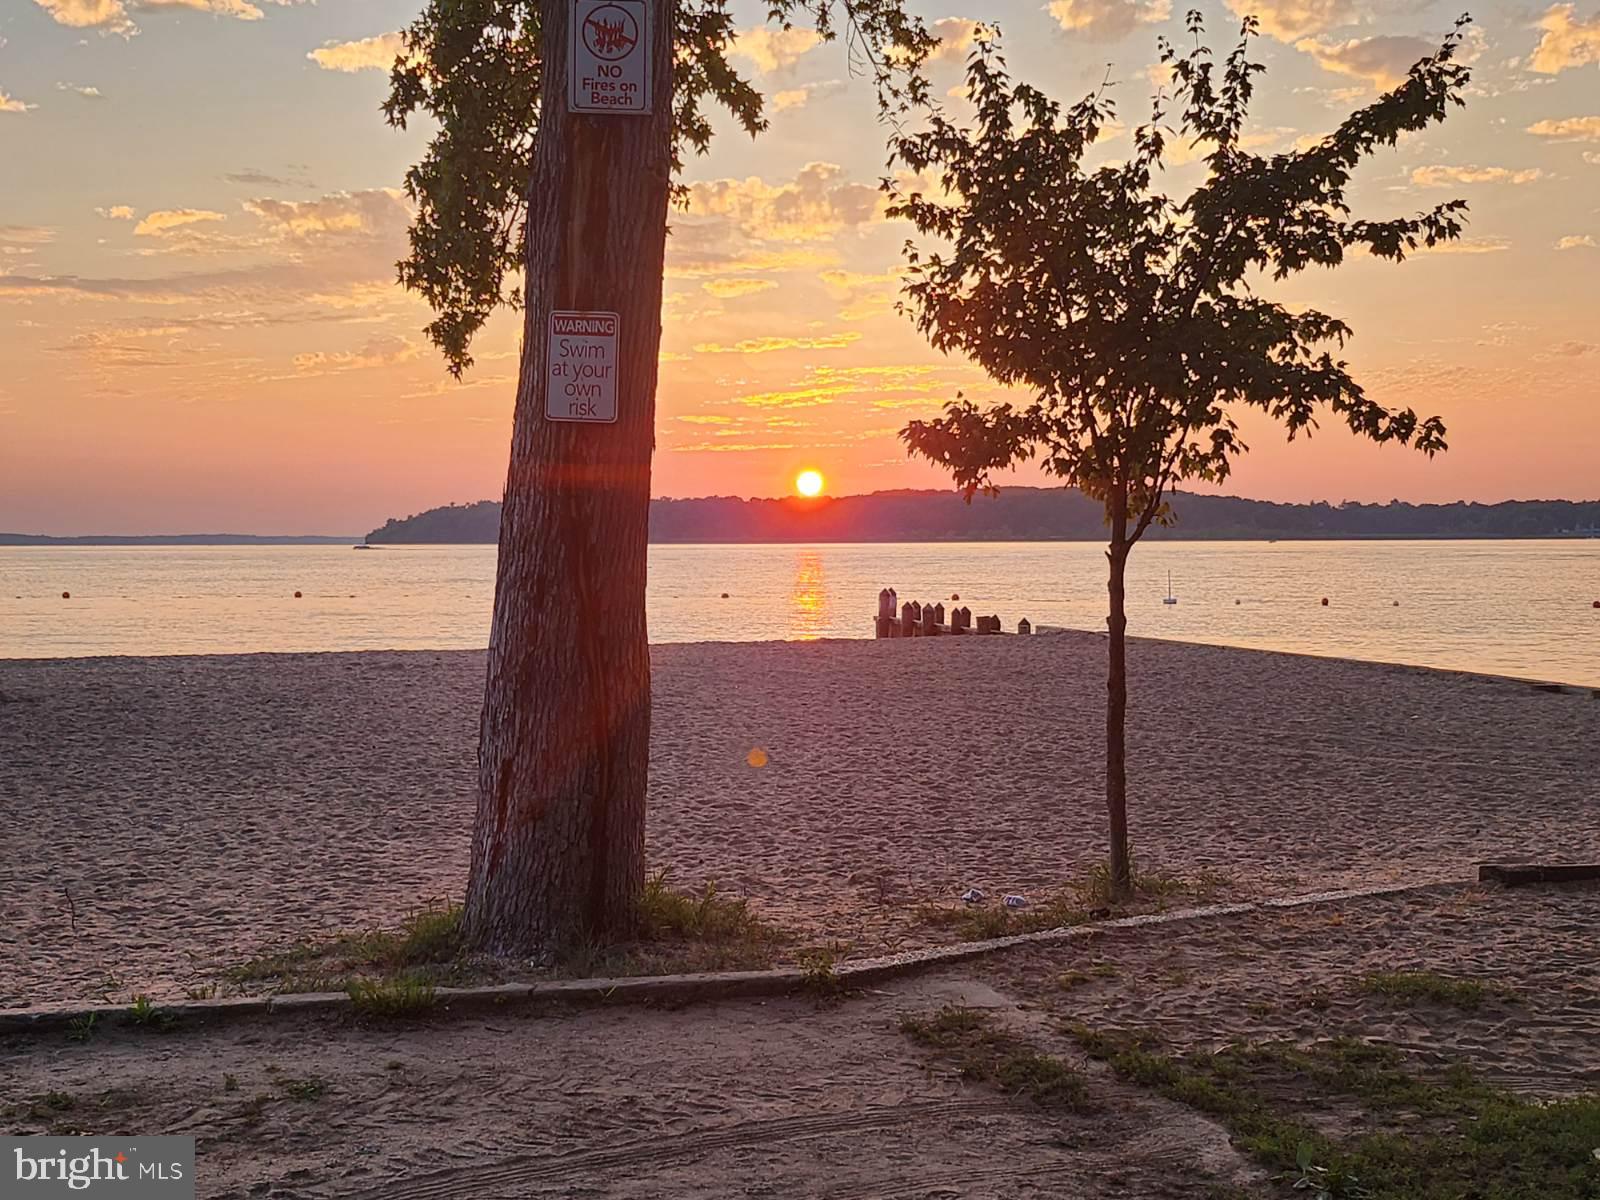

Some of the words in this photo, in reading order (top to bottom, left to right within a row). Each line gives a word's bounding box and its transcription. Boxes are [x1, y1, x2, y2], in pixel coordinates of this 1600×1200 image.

[597, 65, 622, 78] NO
[582, 78, 616, 91] Fires
[620, 82, 637, 92] on
[591, 92, 632, 105] Beach
[554, 319, 614, 333] WARNING
[559, 339, 605, 359] Swim
[552, 362, 568, 376] at
[572, 364, 612, 382] your
[564, 383, 601, 397] own
[569, 398, 597, 416] risk
